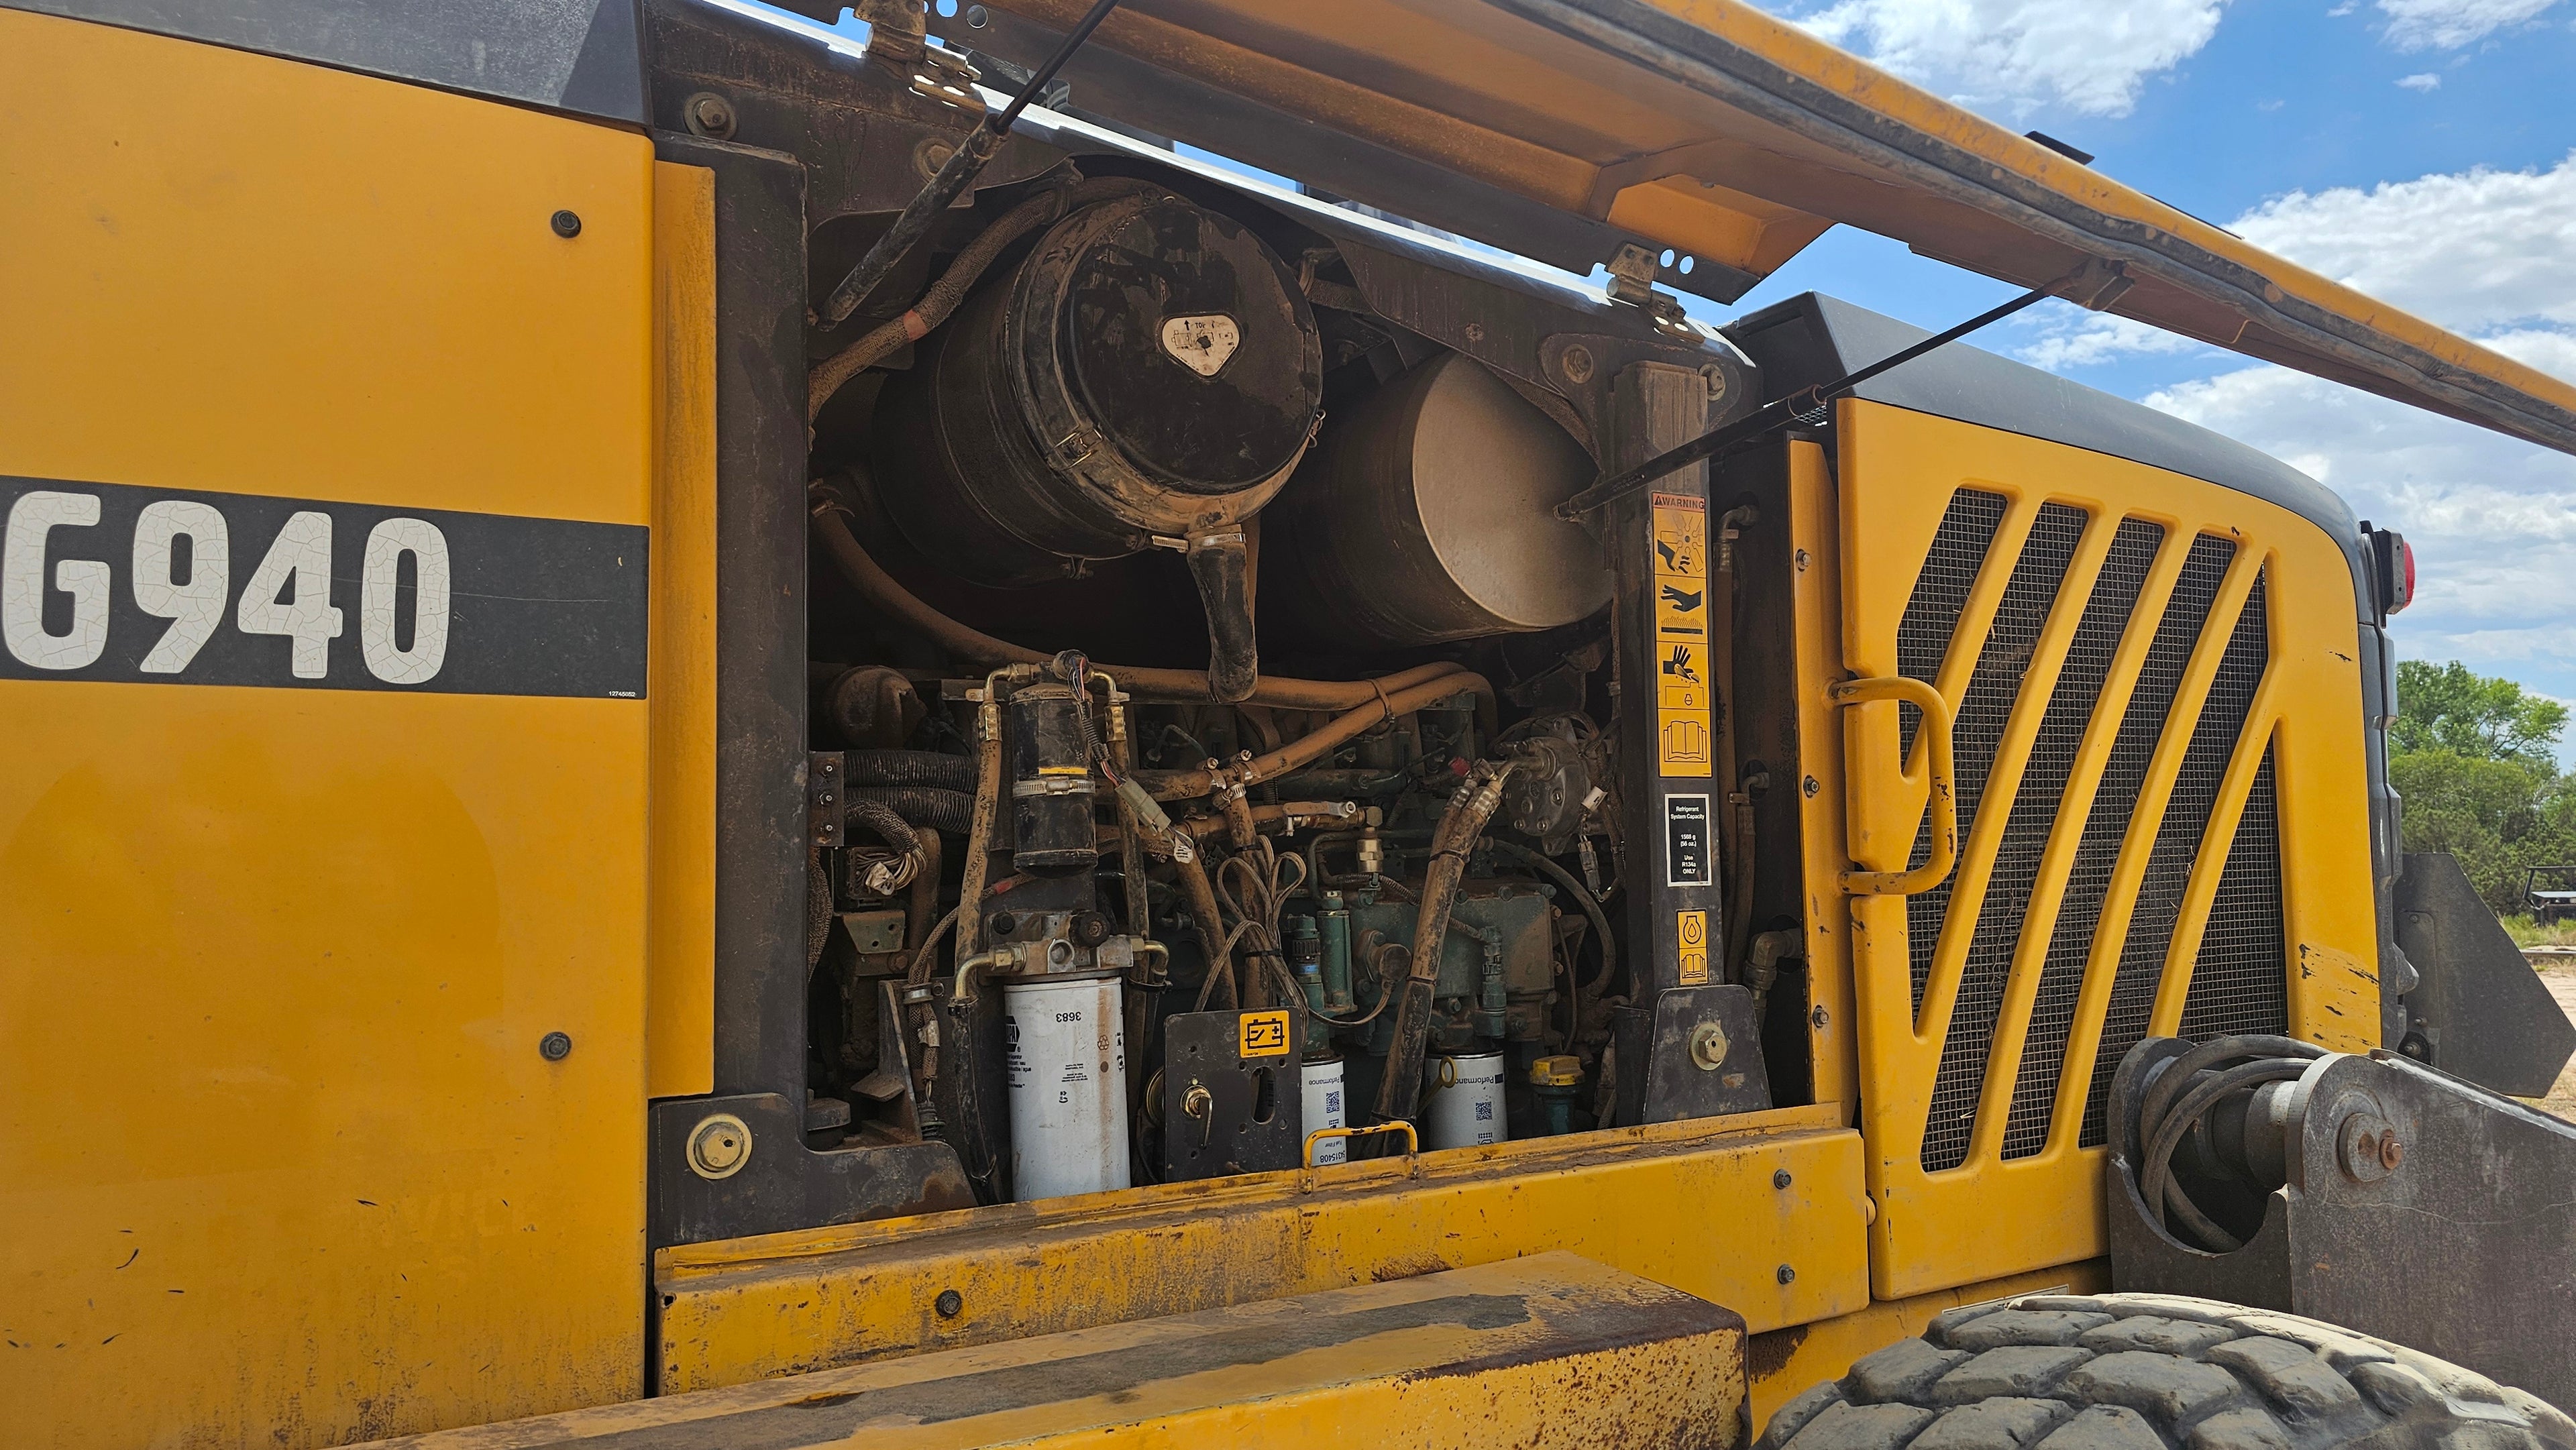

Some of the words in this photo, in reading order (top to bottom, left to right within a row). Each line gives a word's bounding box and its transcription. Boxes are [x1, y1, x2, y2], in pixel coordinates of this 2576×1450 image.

[1662, 497, 1704, 509] WARNING
[2, 490, 450, 684] G940
[1056, 1011, 1081, 1023] 3683
[1455, 1076, 1495, 1085] Performanc
